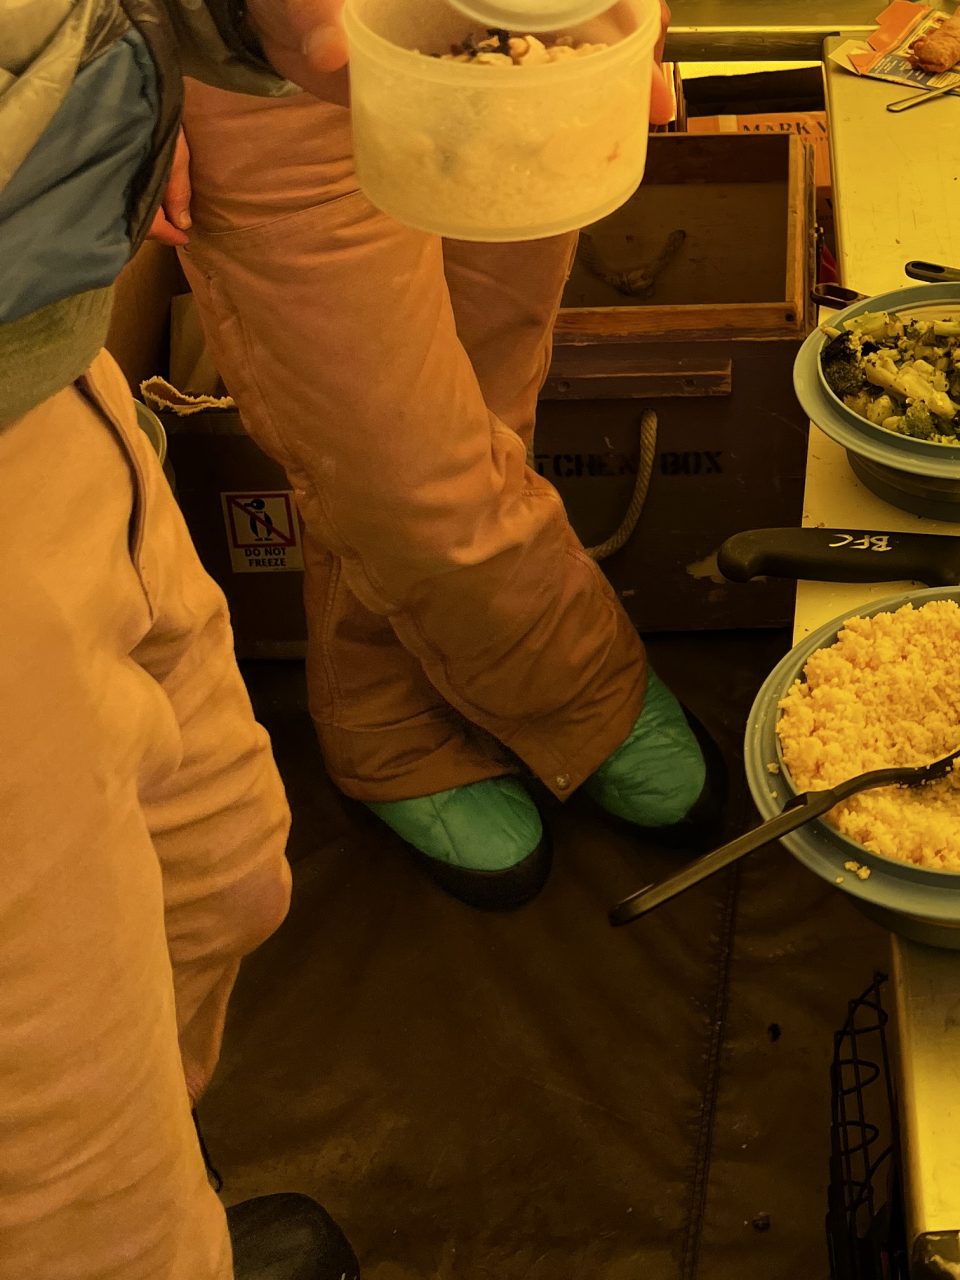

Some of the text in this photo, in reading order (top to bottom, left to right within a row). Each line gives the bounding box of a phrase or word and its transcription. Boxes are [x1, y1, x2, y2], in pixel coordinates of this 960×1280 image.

[536, 450, 723, 478] TCHEN BOX
[245, 548, 286, 557] DO NOT
[249, 558, 287, 567] FREEZE
